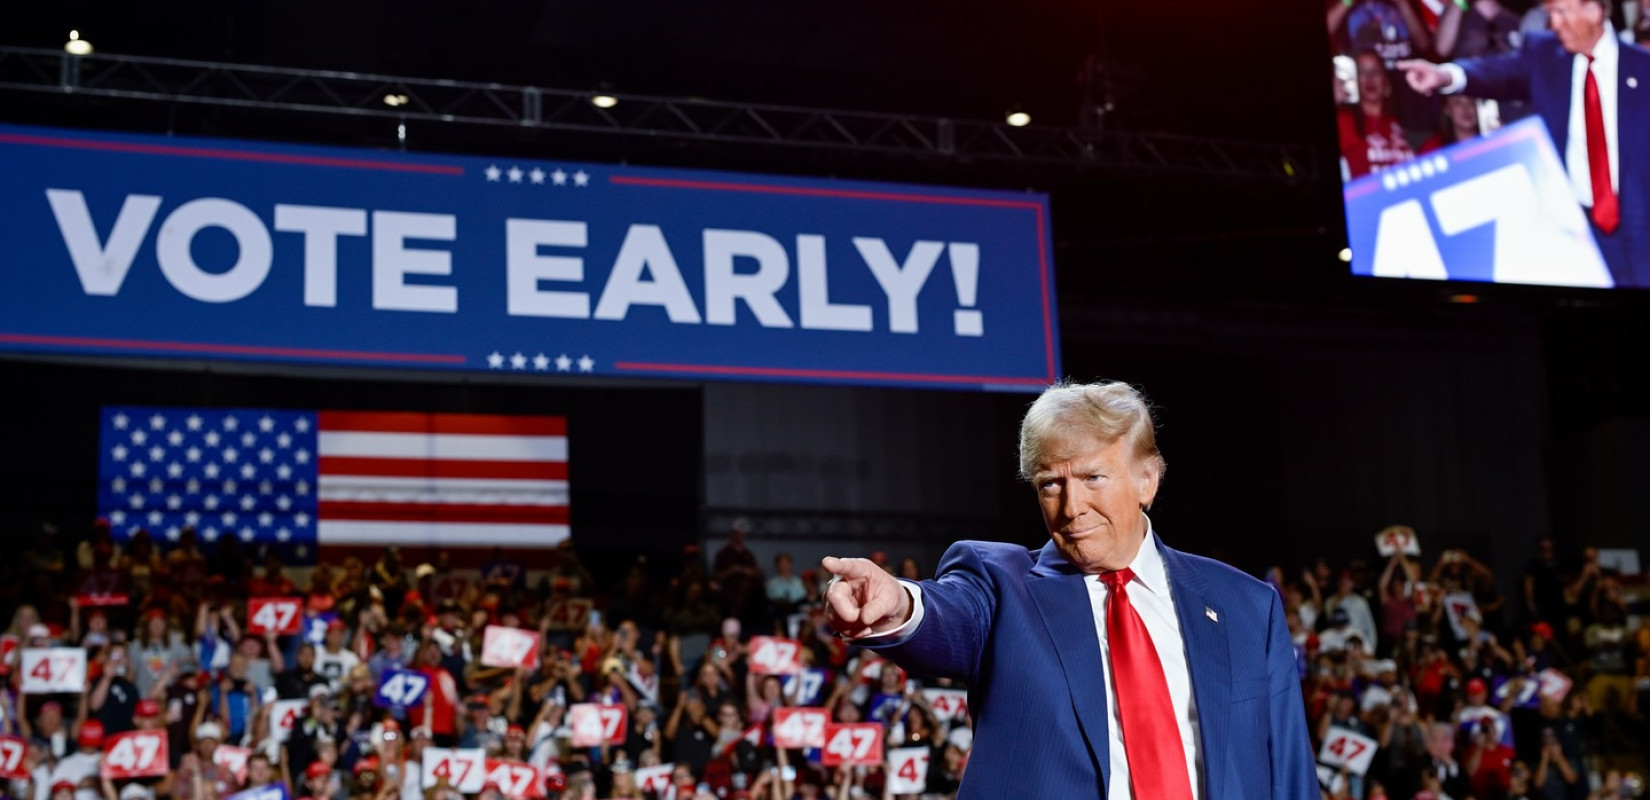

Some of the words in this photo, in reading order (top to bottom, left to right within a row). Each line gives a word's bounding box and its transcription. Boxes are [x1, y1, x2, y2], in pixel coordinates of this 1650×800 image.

[46, 187, 458, 313] VOTE
[507, 218, 985, 337] EARLY!
[252, 601, 298, 631] 47
[552, 603, 587, 624] 47
[490, 634, 534, 664] 47
[753, 640, 797, 673] 47
[31, 658, 76, 683] 47
[380, 673, 427, 705] 47
[576, 707, 622, 740] 47
[779, 711, 825, 746] 47
[106, 735, 161, 769] 47
[827, 727, 876, 759] 47
[1329, 737, 1366, 761] 47
[432, 757, 474, 787] 47
[488, 763, 535, 796] 47
[897, 755, 931, 782] 4
